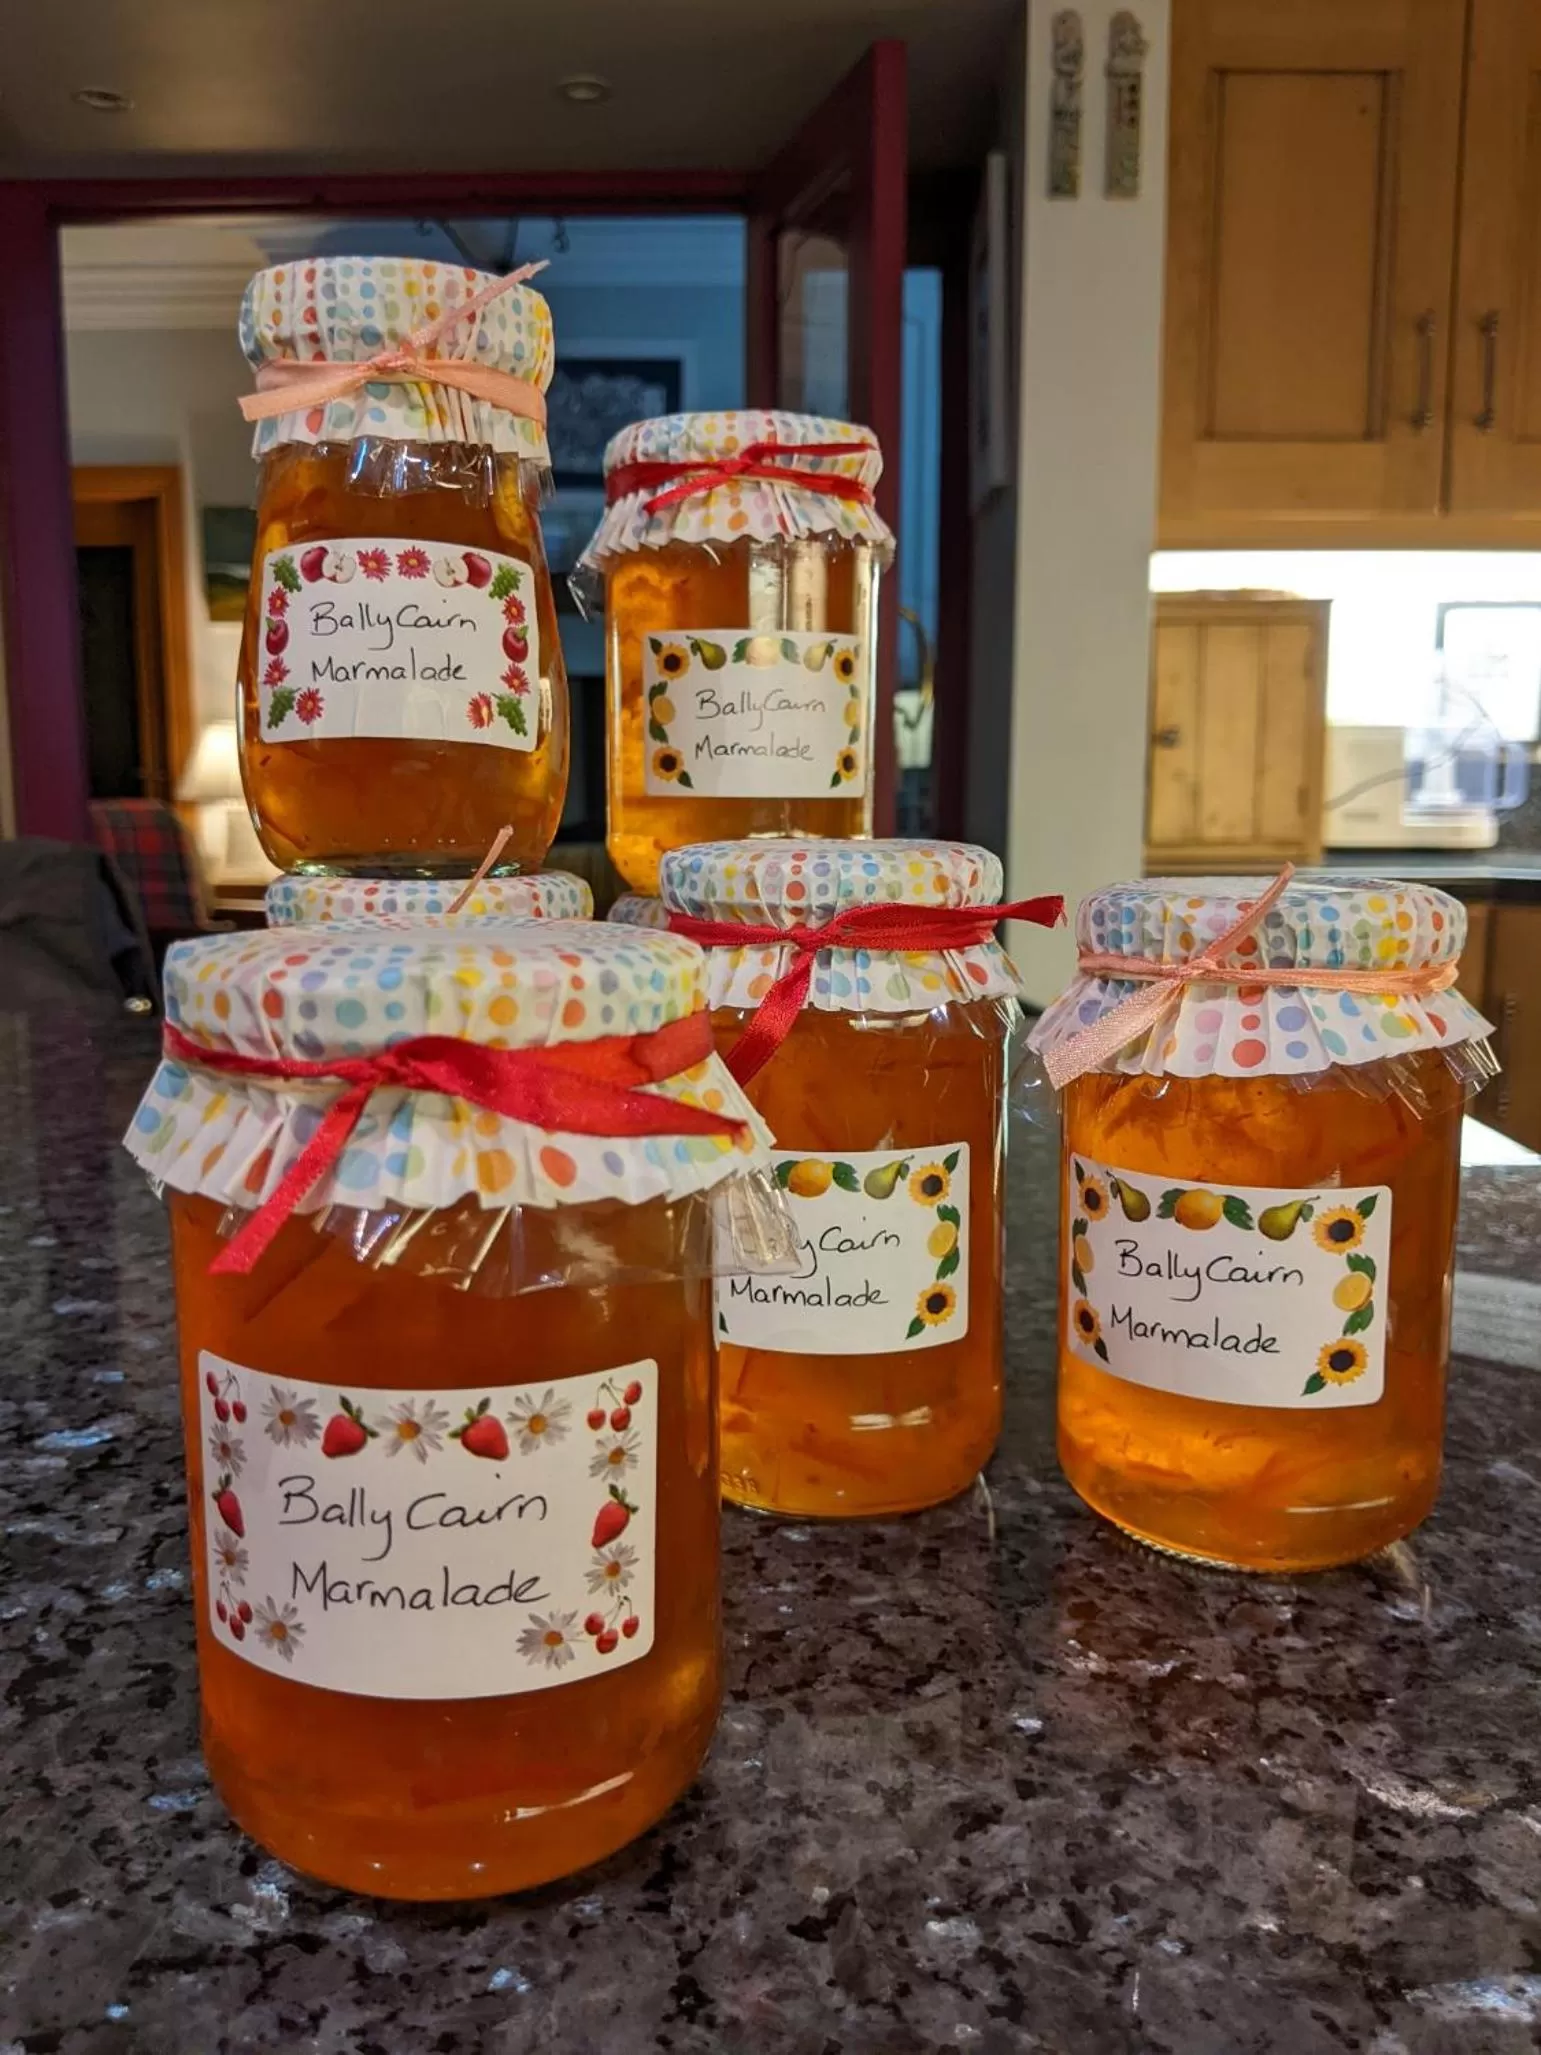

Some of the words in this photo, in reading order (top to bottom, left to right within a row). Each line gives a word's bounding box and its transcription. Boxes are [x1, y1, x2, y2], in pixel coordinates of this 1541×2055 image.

[311, 647, 467, 682] Marmalade
[694, 731, 815, 761] Marmalade
[730, 1275, 889, 1307] Marmalade
[1109, 1303, 1281, 1354] Marmalade
[291, 1560, 550, 1611] Marmalade
